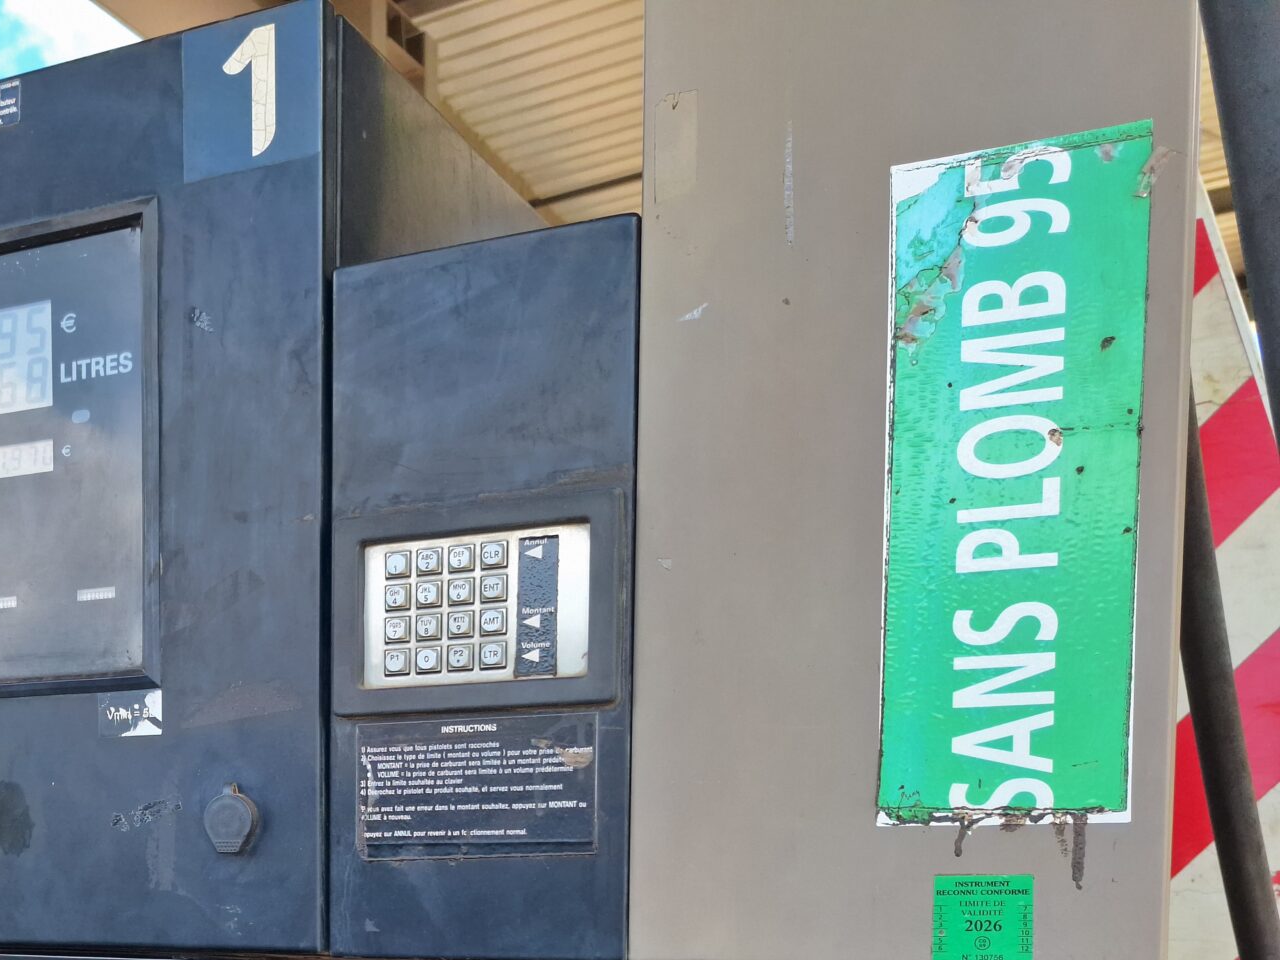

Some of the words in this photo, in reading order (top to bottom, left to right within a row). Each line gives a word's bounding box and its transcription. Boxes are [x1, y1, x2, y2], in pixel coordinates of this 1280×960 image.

[222, 23, 276, 157] 1
[962, 146, 1071, 247] 95
[60, 313, 77, 333] €
[60, 351, 133, 384] LITRES
[956, 270, 1067, 573] PLOMB
[483, 550, 500, 559] CLR
[483, 582, 500, 592] ENT
[522, 606, 556, 614] Montant
[483, 616, 500, 626] AMT
[521, 641, 551, 649] Volume
[483, 650, 499, 659] LTR
[949, 602, 1058, 815] SANS
[441, 724, 497, 733] INSTRUCTIONS
[366, 745, 388, 753] Assurez
[402, 745, 414, 753] que
[428, 743, 453, 752] pistolets
[468, 741, 500, 749] raccrochés
[367, 754, 396, 762] Choisissez
[404, 753, 416, 761] type
[507, 749, 521, 757] pour
[539, 747, 554, 755] prise
[377, 762, 403, 770] MONTANT
[416, 761, 430, 769] prise
[440, 759, 467, 768] carburant
[517, 757, 541, 765] montant
[412, 770, 427, 778] prise
[436, 769, 463, 777] carburant
[513, 766, 534, 774] volume
[408, 778, 435, 786] souhaitée
[403, 787, 424, 796] pistolet
[434, 786, 454, 795] produit
[525, 783, 563, 791] normalement
[511, 802, 536, 810] appuyez
[548, 800, 578, 808] MONTANT
[965, 920, 1002, 932] 2026
